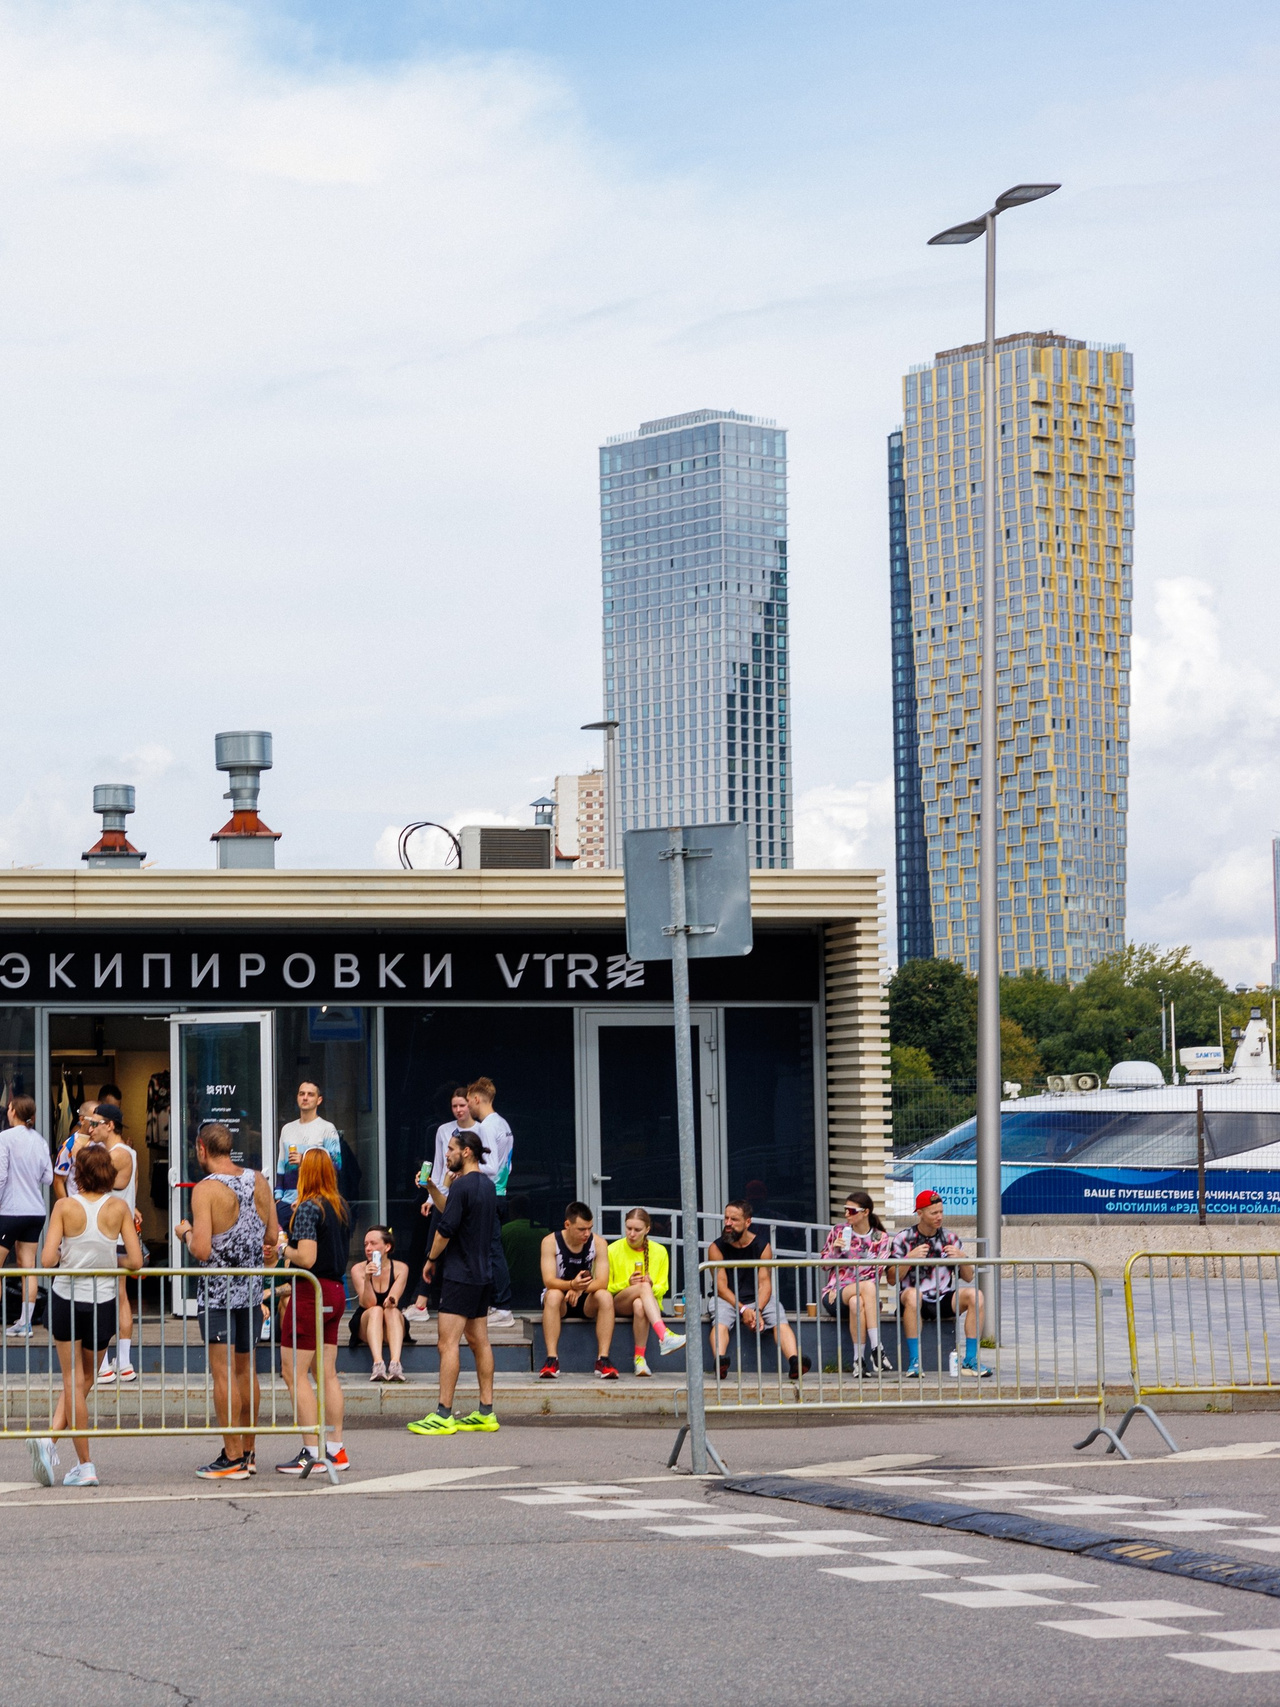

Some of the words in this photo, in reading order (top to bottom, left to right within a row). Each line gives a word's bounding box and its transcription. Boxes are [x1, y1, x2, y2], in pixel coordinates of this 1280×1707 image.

[0, 952, 452, 989] ЭКИПИРОВКИ
[495, 953, 599, 989] VTR
[932, 1186, 975, 1195] БИЛЕТЫ
[1084, 1189, 1116, 1198] ВАШЕ
[1118, 1189, 1194, 1199] ПУТЕШЕСТВИЕ
[941, 1196, 969, 1205] 2100
[1105, 1201, 1167, 1212] ФЛОТИЛИЯ
[1170, 1202, 1237, 1214] «РЭДССОН
